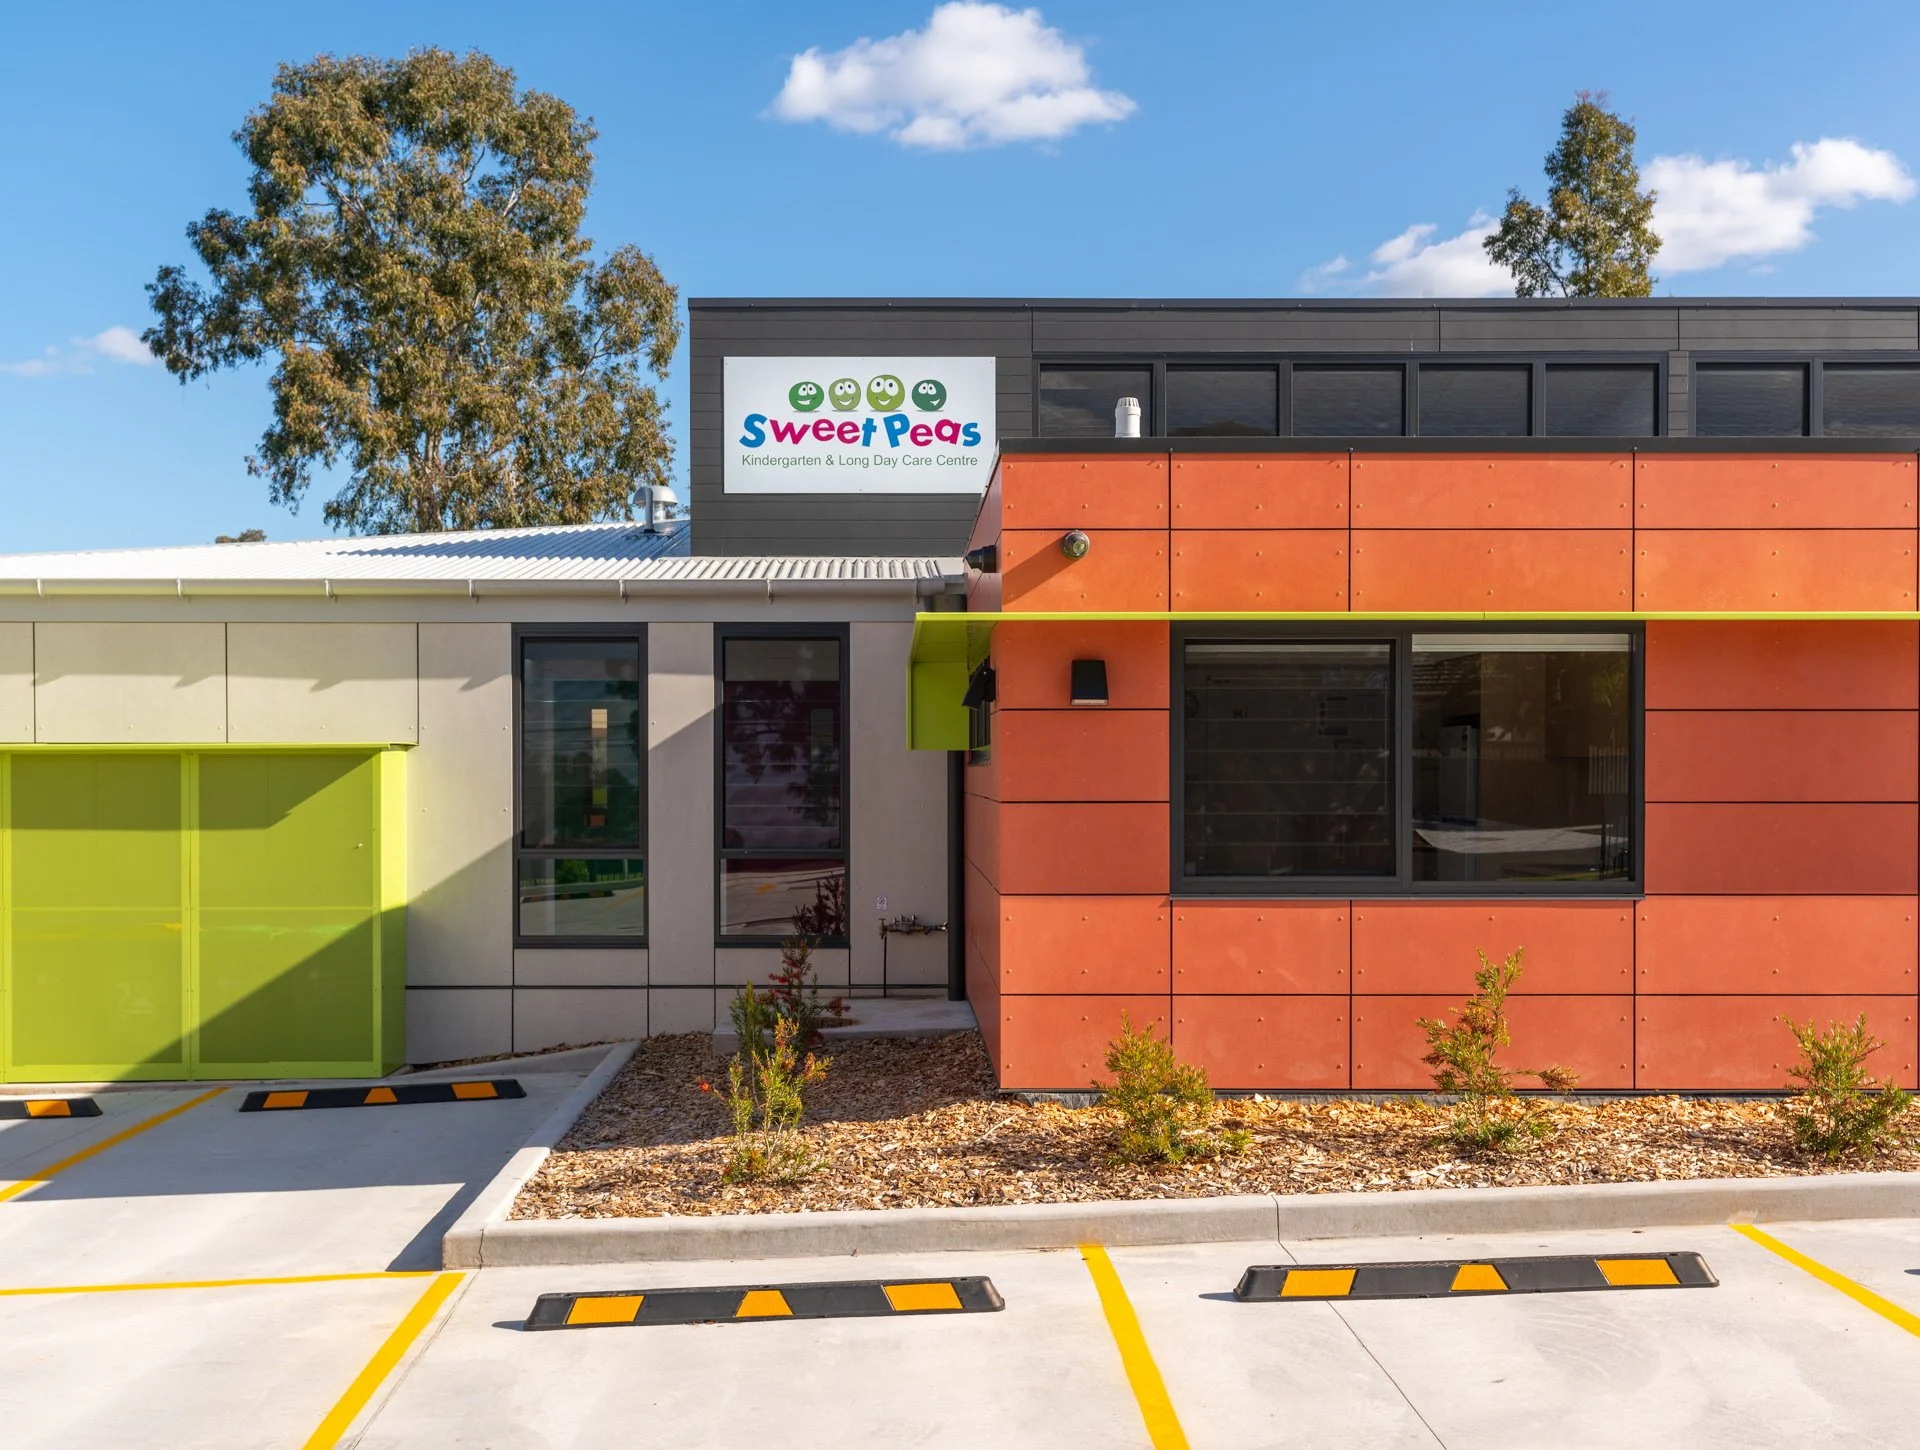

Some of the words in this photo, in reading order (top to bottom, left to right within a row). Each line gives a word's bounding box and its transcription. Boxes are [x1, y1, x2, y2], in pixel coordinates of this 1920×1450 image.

[739, 413, 877, 448] Sweet
[883, 413, 982, 448] Peas
[742, 454, 821, 468] Kindergarten
[825, 454, 834, 465] &
[839, 454, 869, 468] Long
[874, 454, 898, 468] Day
[902, 454, 932, 466] Care
[936, 454, 978, 466] Centre
